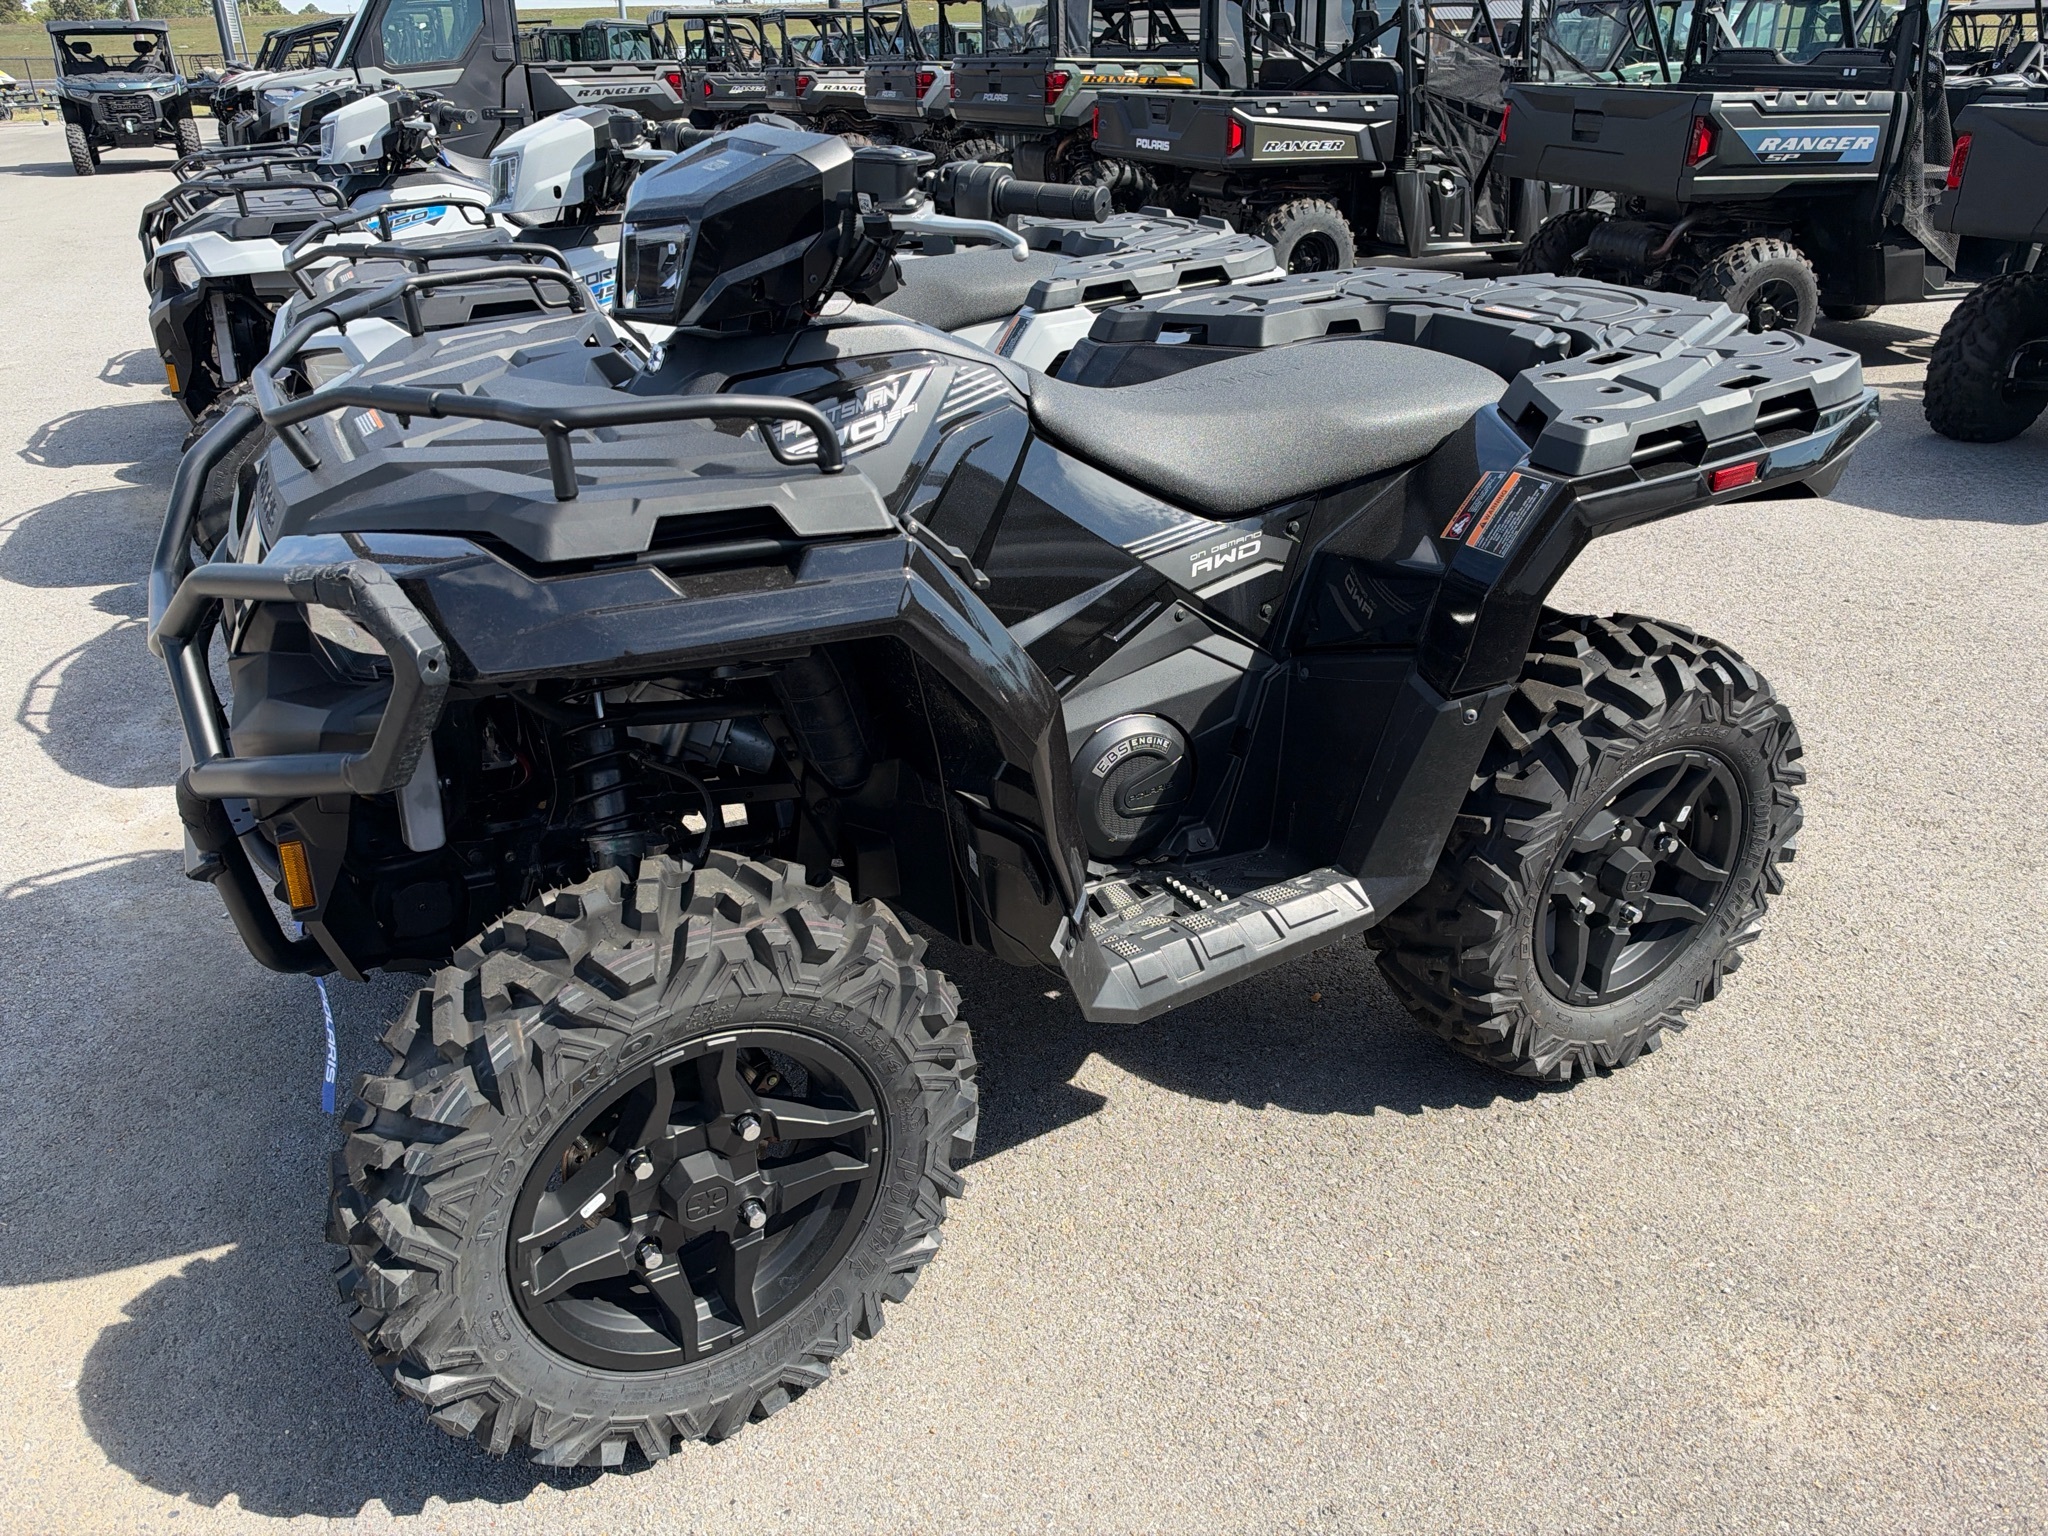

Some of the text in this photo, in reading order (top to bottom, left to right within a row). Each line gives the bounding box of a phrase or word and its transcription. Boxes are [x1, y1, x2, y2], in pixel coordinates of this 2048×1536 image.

[312, 77, 353, 89] XP
[1088, 75, 1158, 84] RANGER
[577, 87, 651, 97] RANGER
[1136, 138, 1170, 151] POLARIS
[1262, 140, 1345, 152] RANGER
[1757, 136, 1874, 151] RANGER
[1764, 153, 1800, 162] SP
[887, 401, 918, 424] EFI
[1485, 490, 1508, 521] WARNING
[1190, 530, 1262, 561] ON DEMAND
[1192, 540, 1261, 577] AWD
[1097, 743, 1129, 774] EBS
[1131, 736, 1169, 748] ENGINE
[318, 984, 338, 1084] POLARIS
